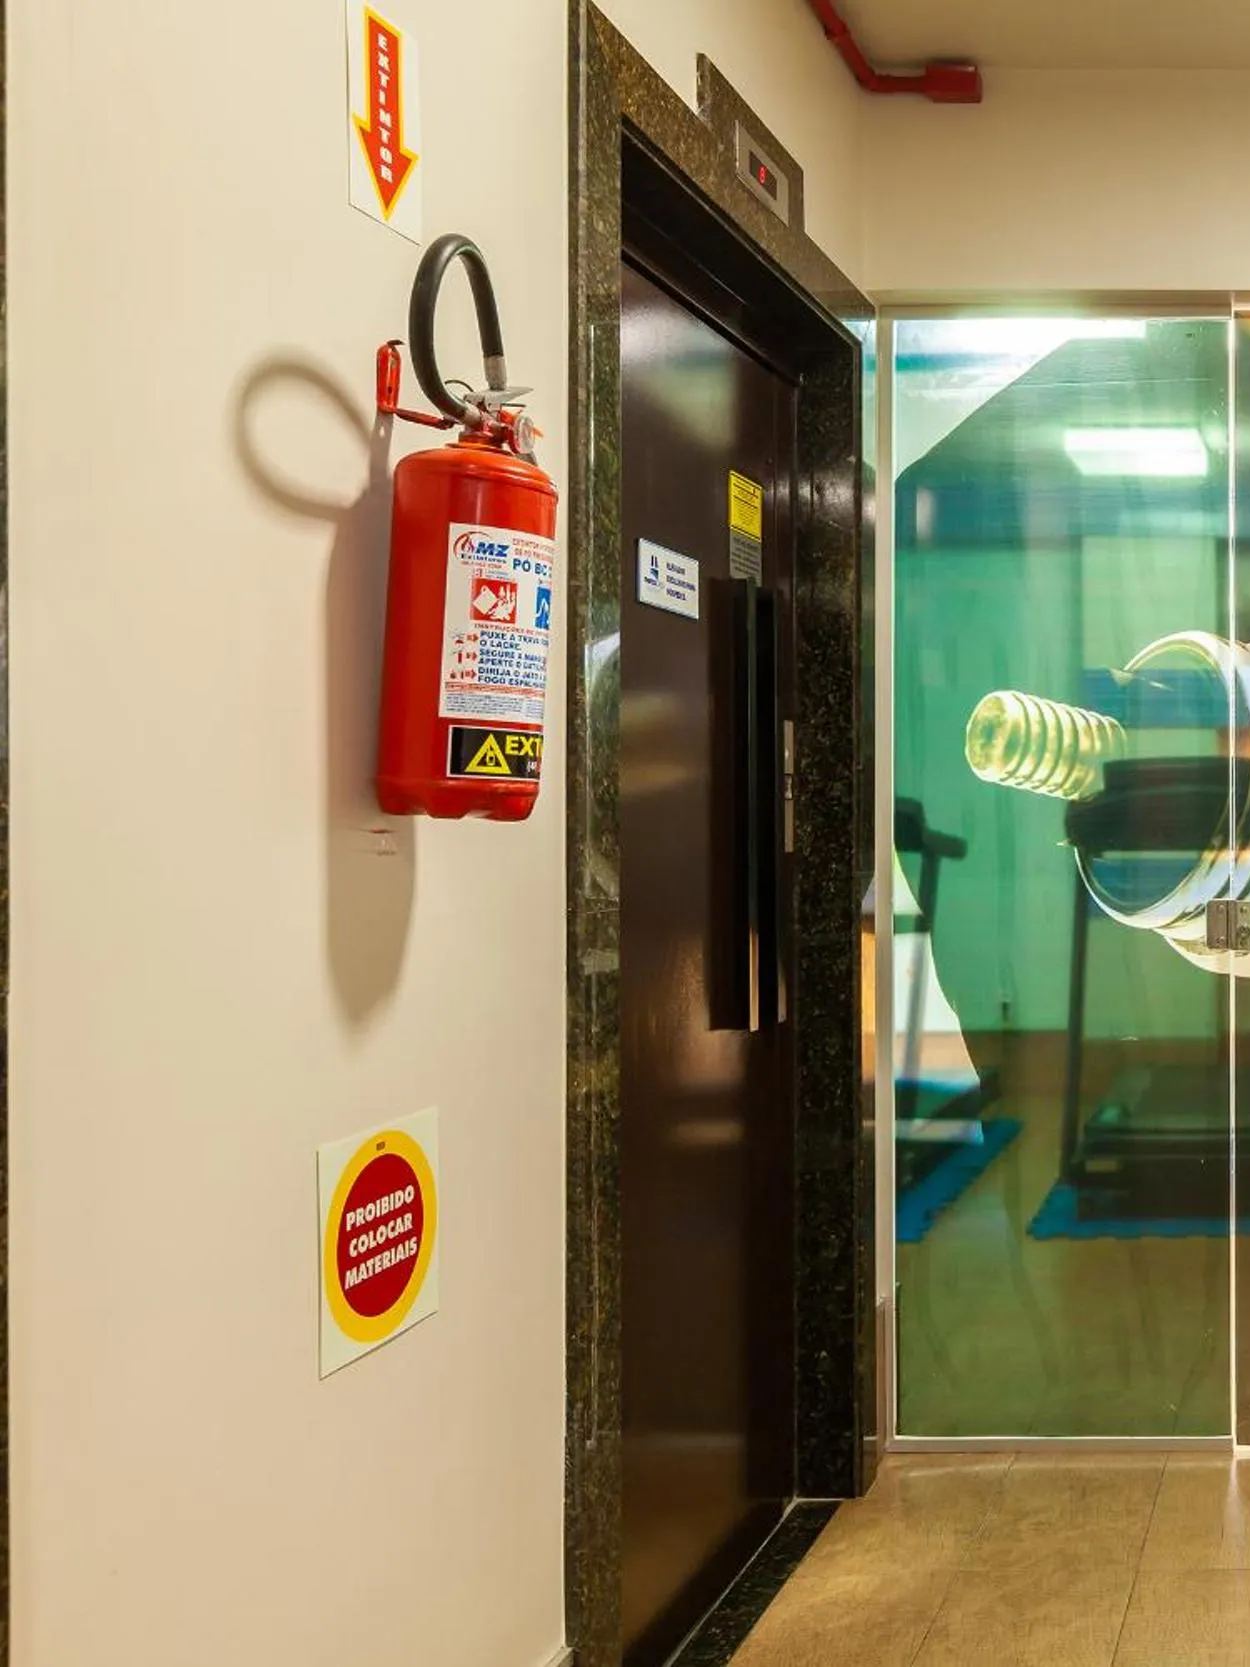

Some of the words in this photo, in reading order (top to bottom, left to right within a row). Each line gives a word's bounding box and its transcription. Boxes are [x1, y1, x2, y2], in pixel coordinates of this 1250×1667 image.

[377, 33, 393, 183] EXTINTOR
[480, 630, 507, 640] PUXE
[479, 639, 487, 647] O
[479, 648, 515, 659] SEGURE
[478, 658, 514, 668] APERTE
[478, 666, 511, 676] DIRIJA
[478, 676, 506, 684] FOGO
[345, 1184, 415, 1232] PROIBIDO
[348, 1213, 413, 1257] COLOCAR
[344, 1237, 418, 1290] MATERIAIS
